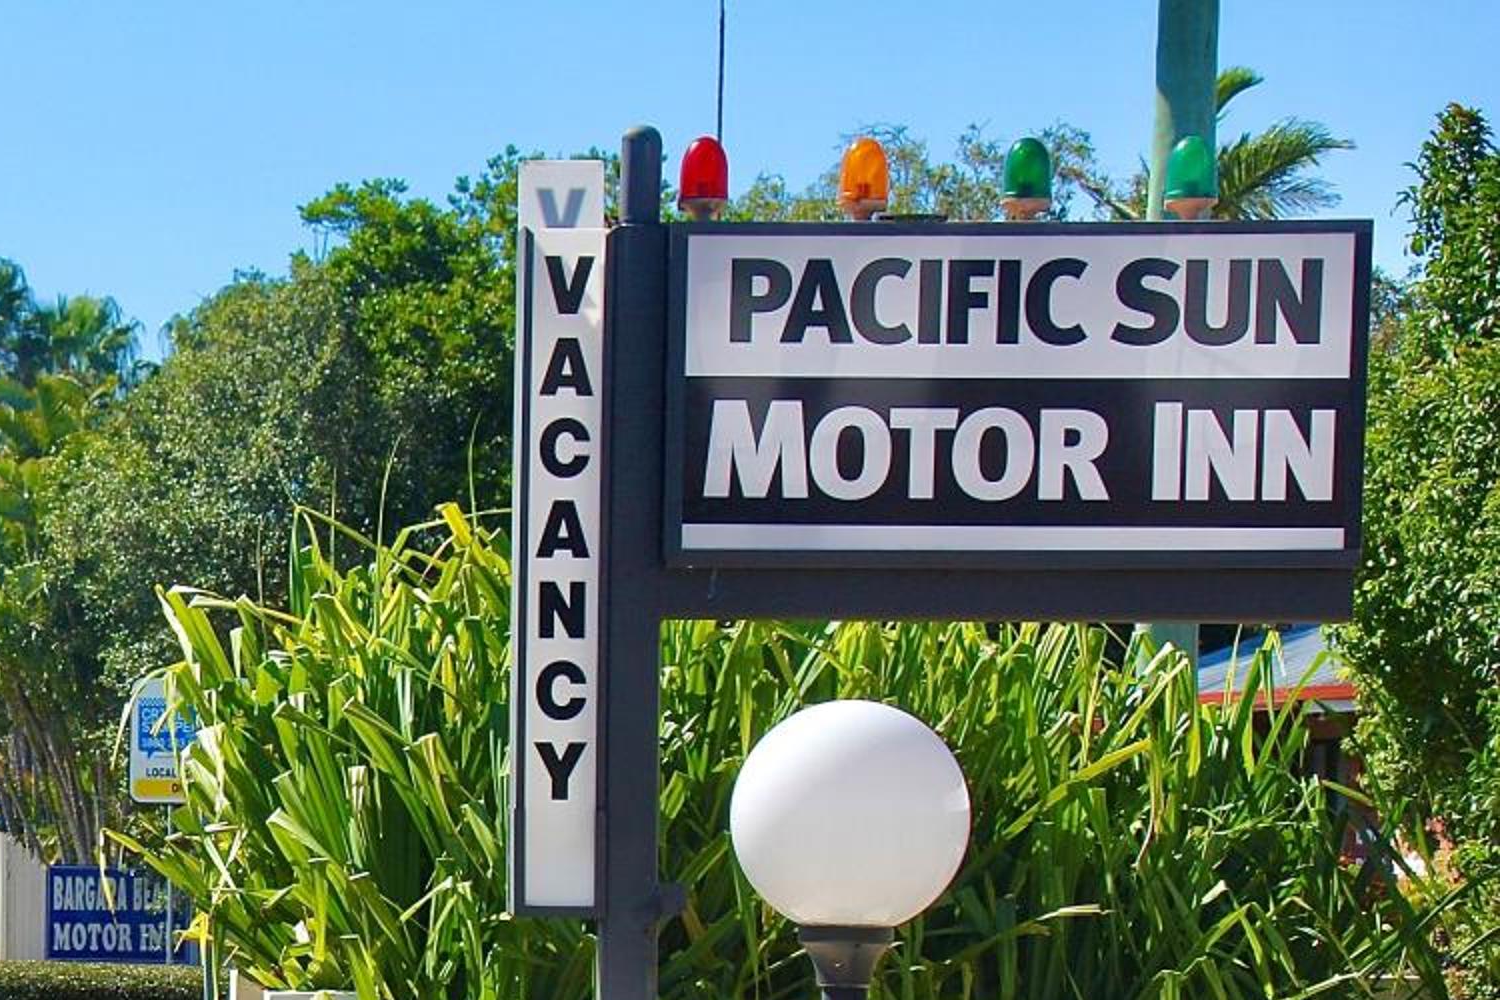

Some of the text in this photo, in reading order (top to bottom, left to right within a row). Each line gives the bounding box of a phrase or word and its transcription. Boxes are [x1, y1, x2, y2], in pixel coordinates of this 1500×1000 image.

[729, 257, 1324, 346] PACIFIC SUN
[703, 399, 1337, 501] MOTOR INN
[535, 255, 596, 801] VACANCY
[146, 767, 177, 778] LOCAL
[53, 922, 133, 951] MOTOR
